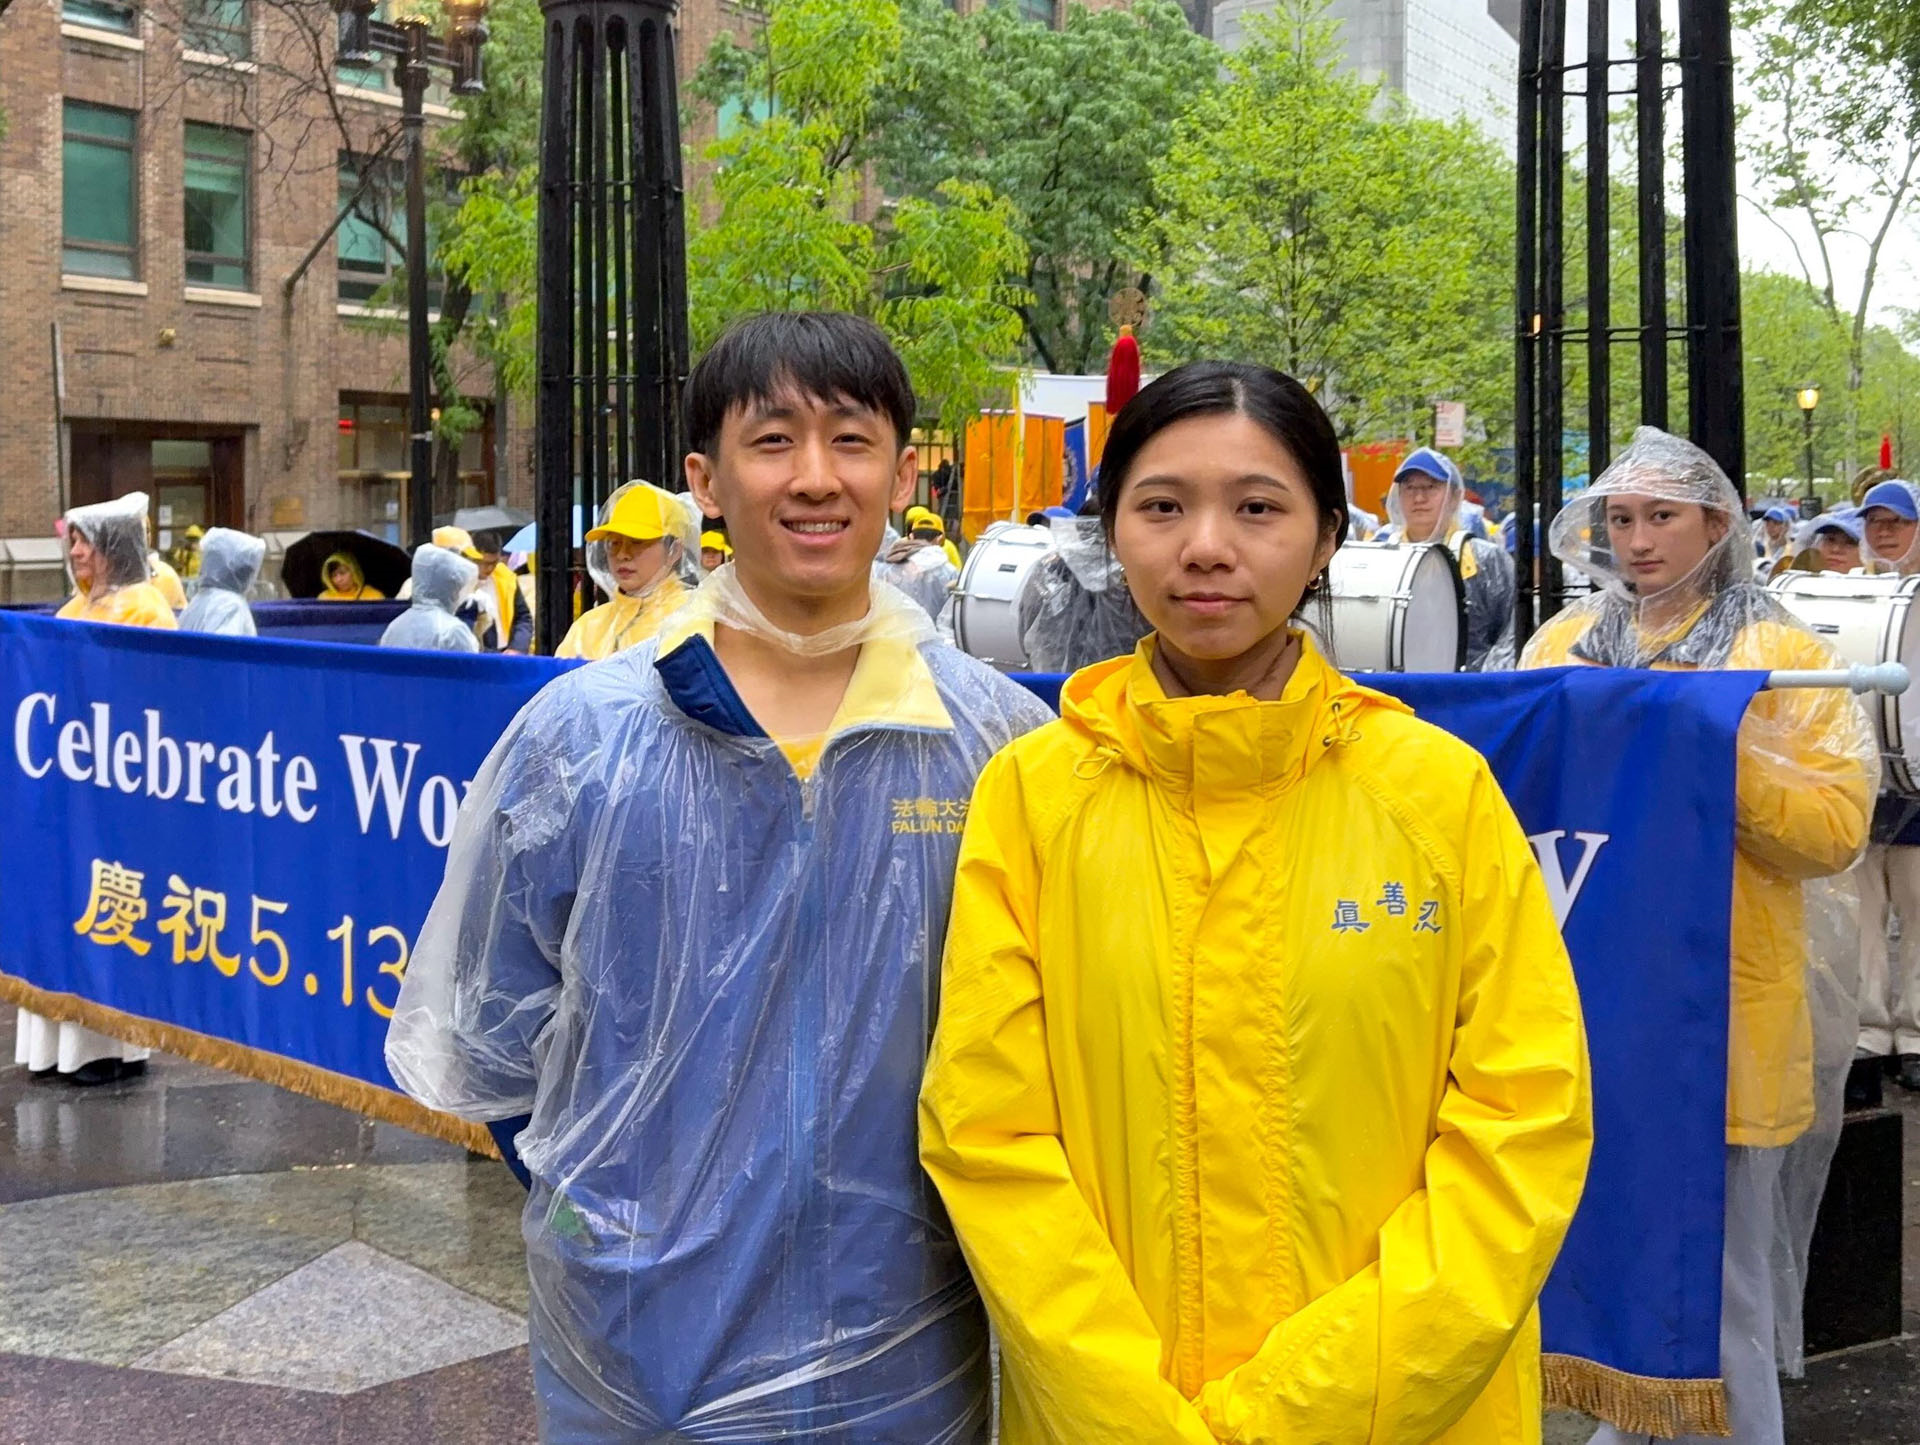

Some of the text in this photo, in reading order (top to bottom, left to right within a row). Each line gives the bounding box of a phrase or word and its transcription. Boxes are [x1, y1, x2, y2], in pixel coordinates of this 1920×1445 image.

[14, 691, 472, 848] Celebrate Wo
[892, 820, 942, 834] FALUN
